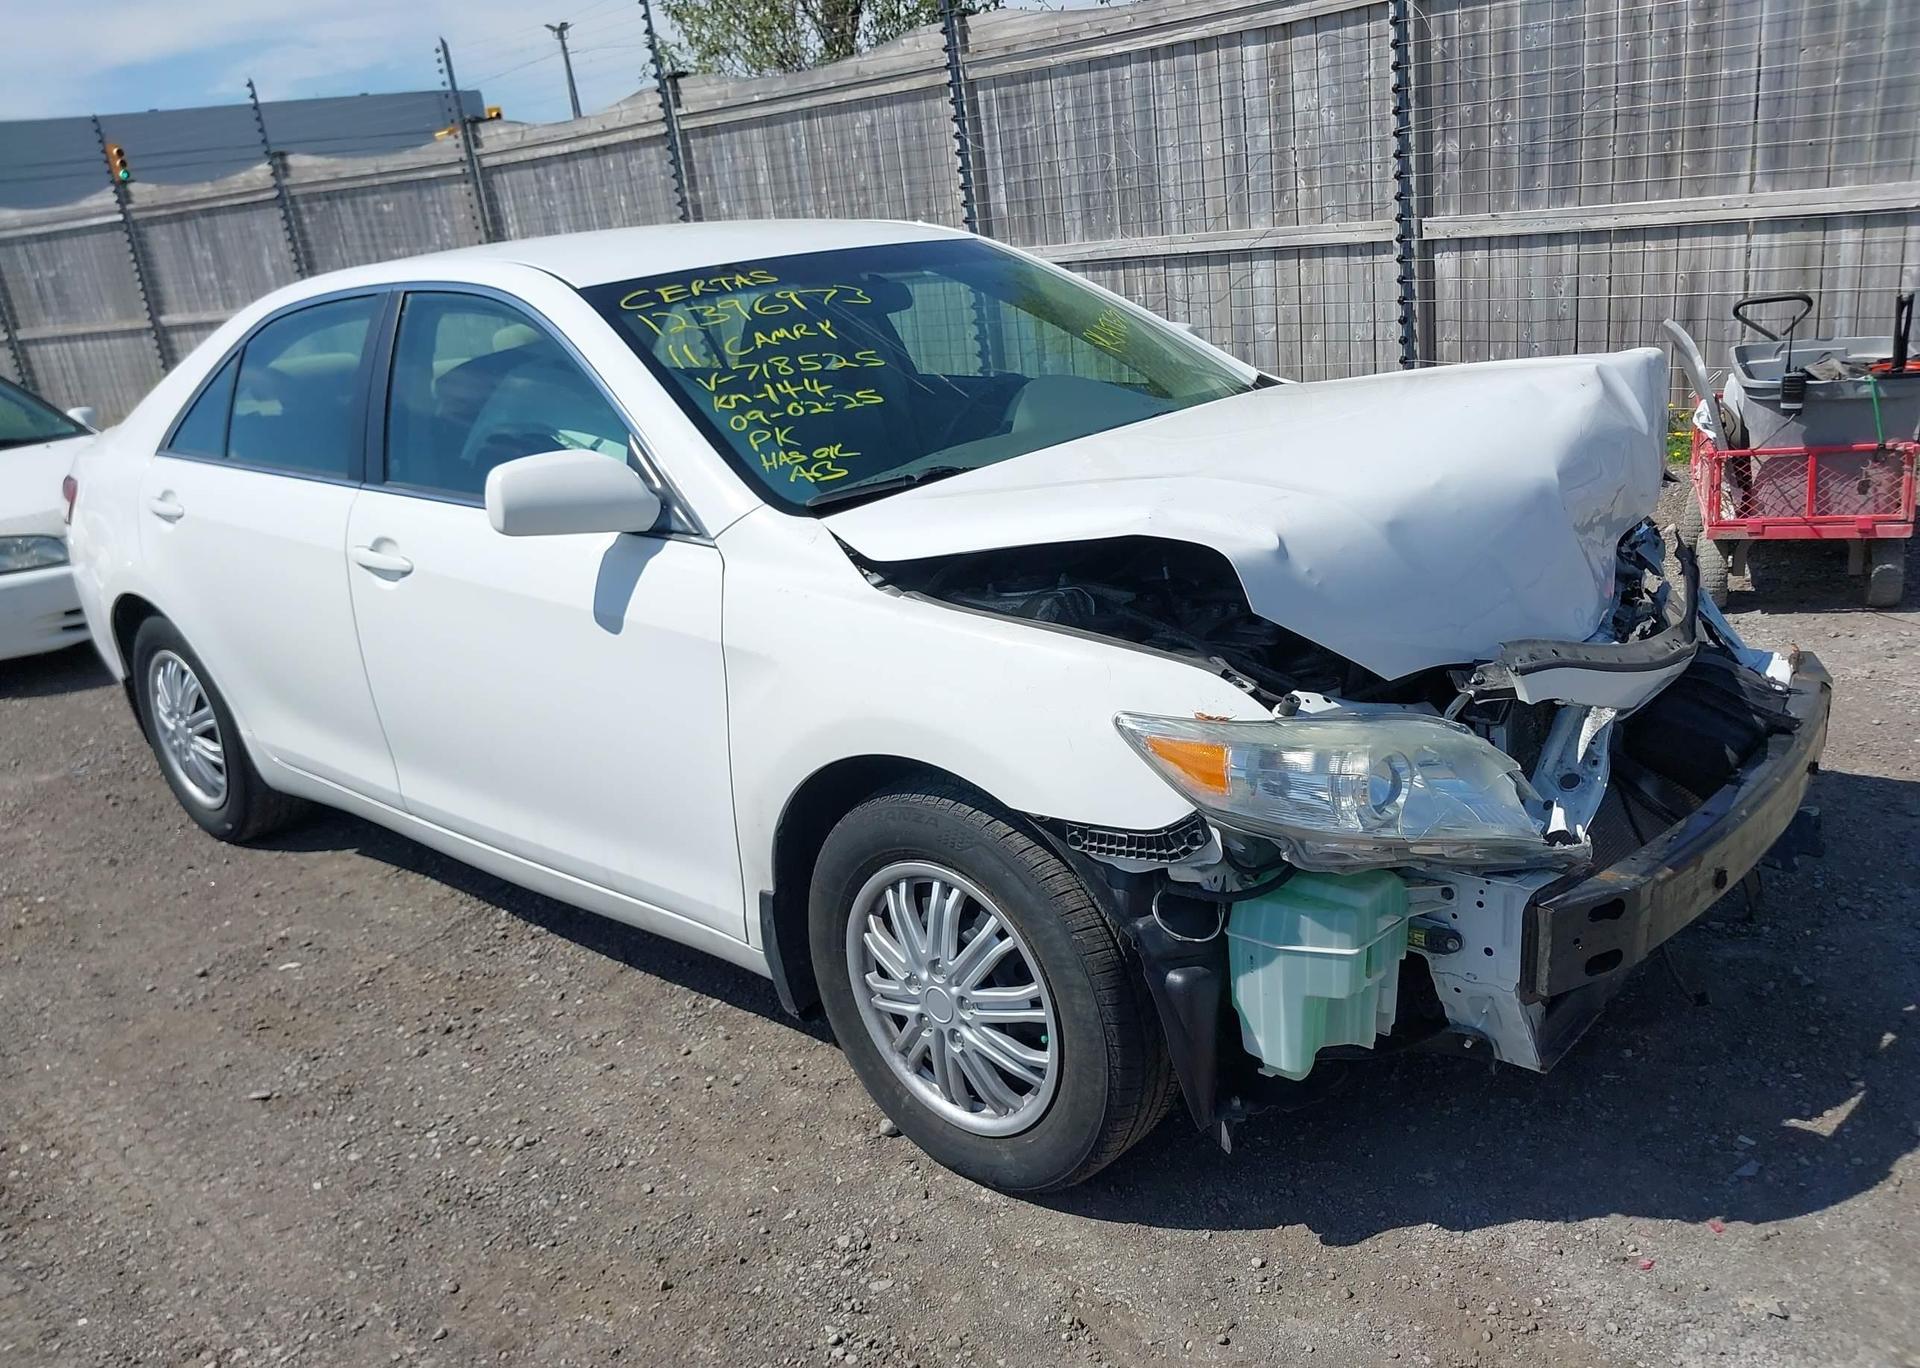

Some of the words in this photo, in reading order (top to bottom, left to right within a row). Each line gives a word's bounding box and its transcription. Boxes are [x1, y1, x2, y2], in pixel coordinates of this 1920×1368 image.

[619, 270, 779, 310] CERTAS
[637, 284, 872, 337] 12396973
[724, 319, 838, 356] CAMRY
[729, 389, 885, 432] 09-02-25
[749, 425, 802, 452] PK
